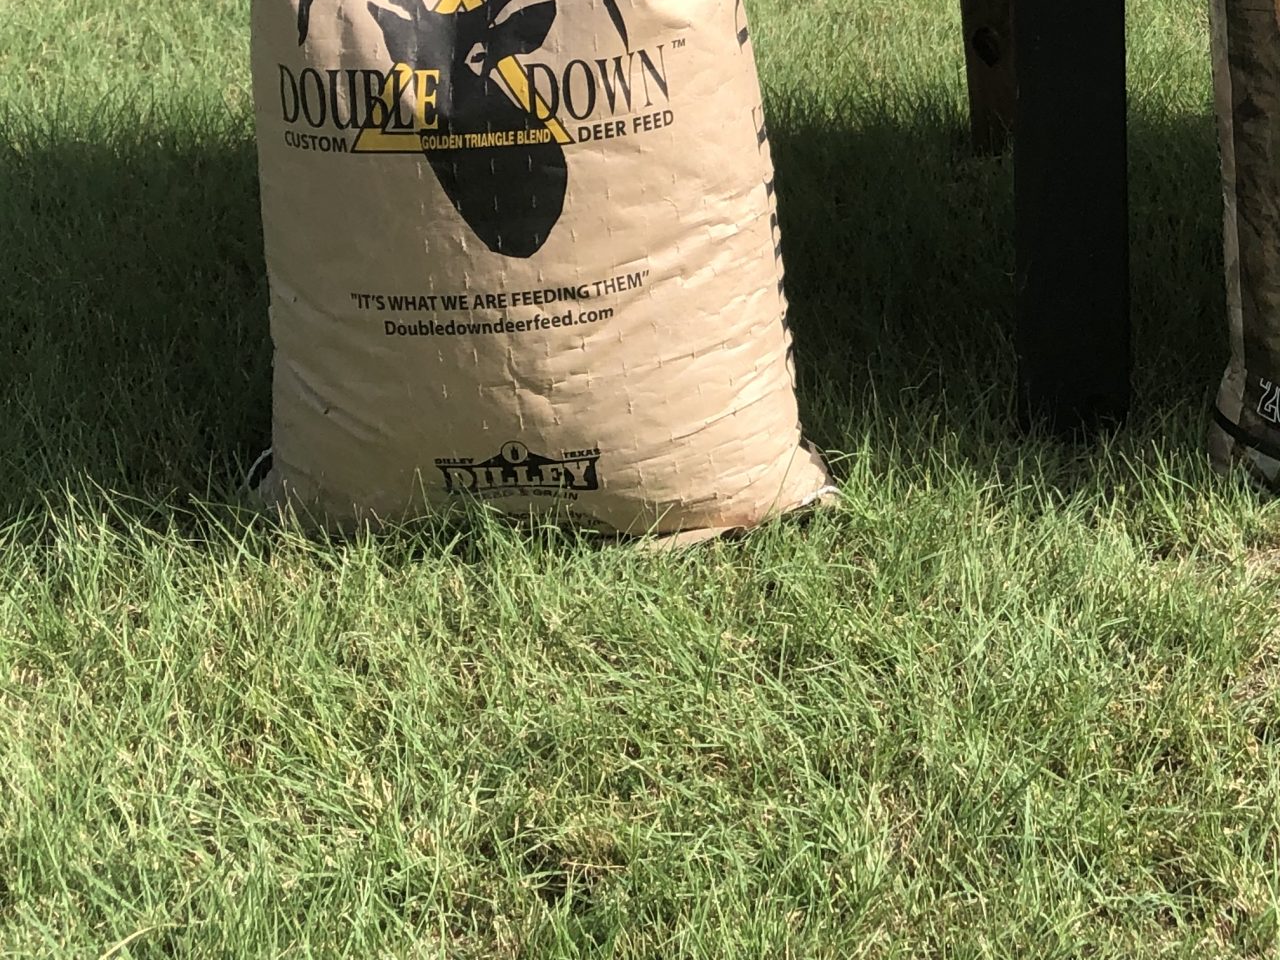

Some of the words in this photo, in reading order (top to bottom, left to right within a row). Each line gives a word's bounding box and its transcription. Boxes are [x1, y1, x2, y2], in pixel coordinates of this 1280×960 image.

[278, 62, 440, 131] DOUBLE
[284, 128, 349, 154] CUSTOM
[422, 134, 464, 151] GOLDEN
[464, 131, 515, 150] TRIANGLE
[516, 128, 551, 147] BLEND
[578, 120, 628, 144] DEER
[632, 109, 676, 136] FEED
[350, 292, 386, 311] "IT'S
[386, 295, 438, 312] WHAT
[442, 293, 468, 311] WE
[473, 291, 507, 310] ARE
[511, 285, 590, 308] FEEDING
[384, 306, 614, 337] Doubledowndeerfeed.com
[563, 447, 602, 459] TEXAS
[441, 458, 600, 491] DILLEY
